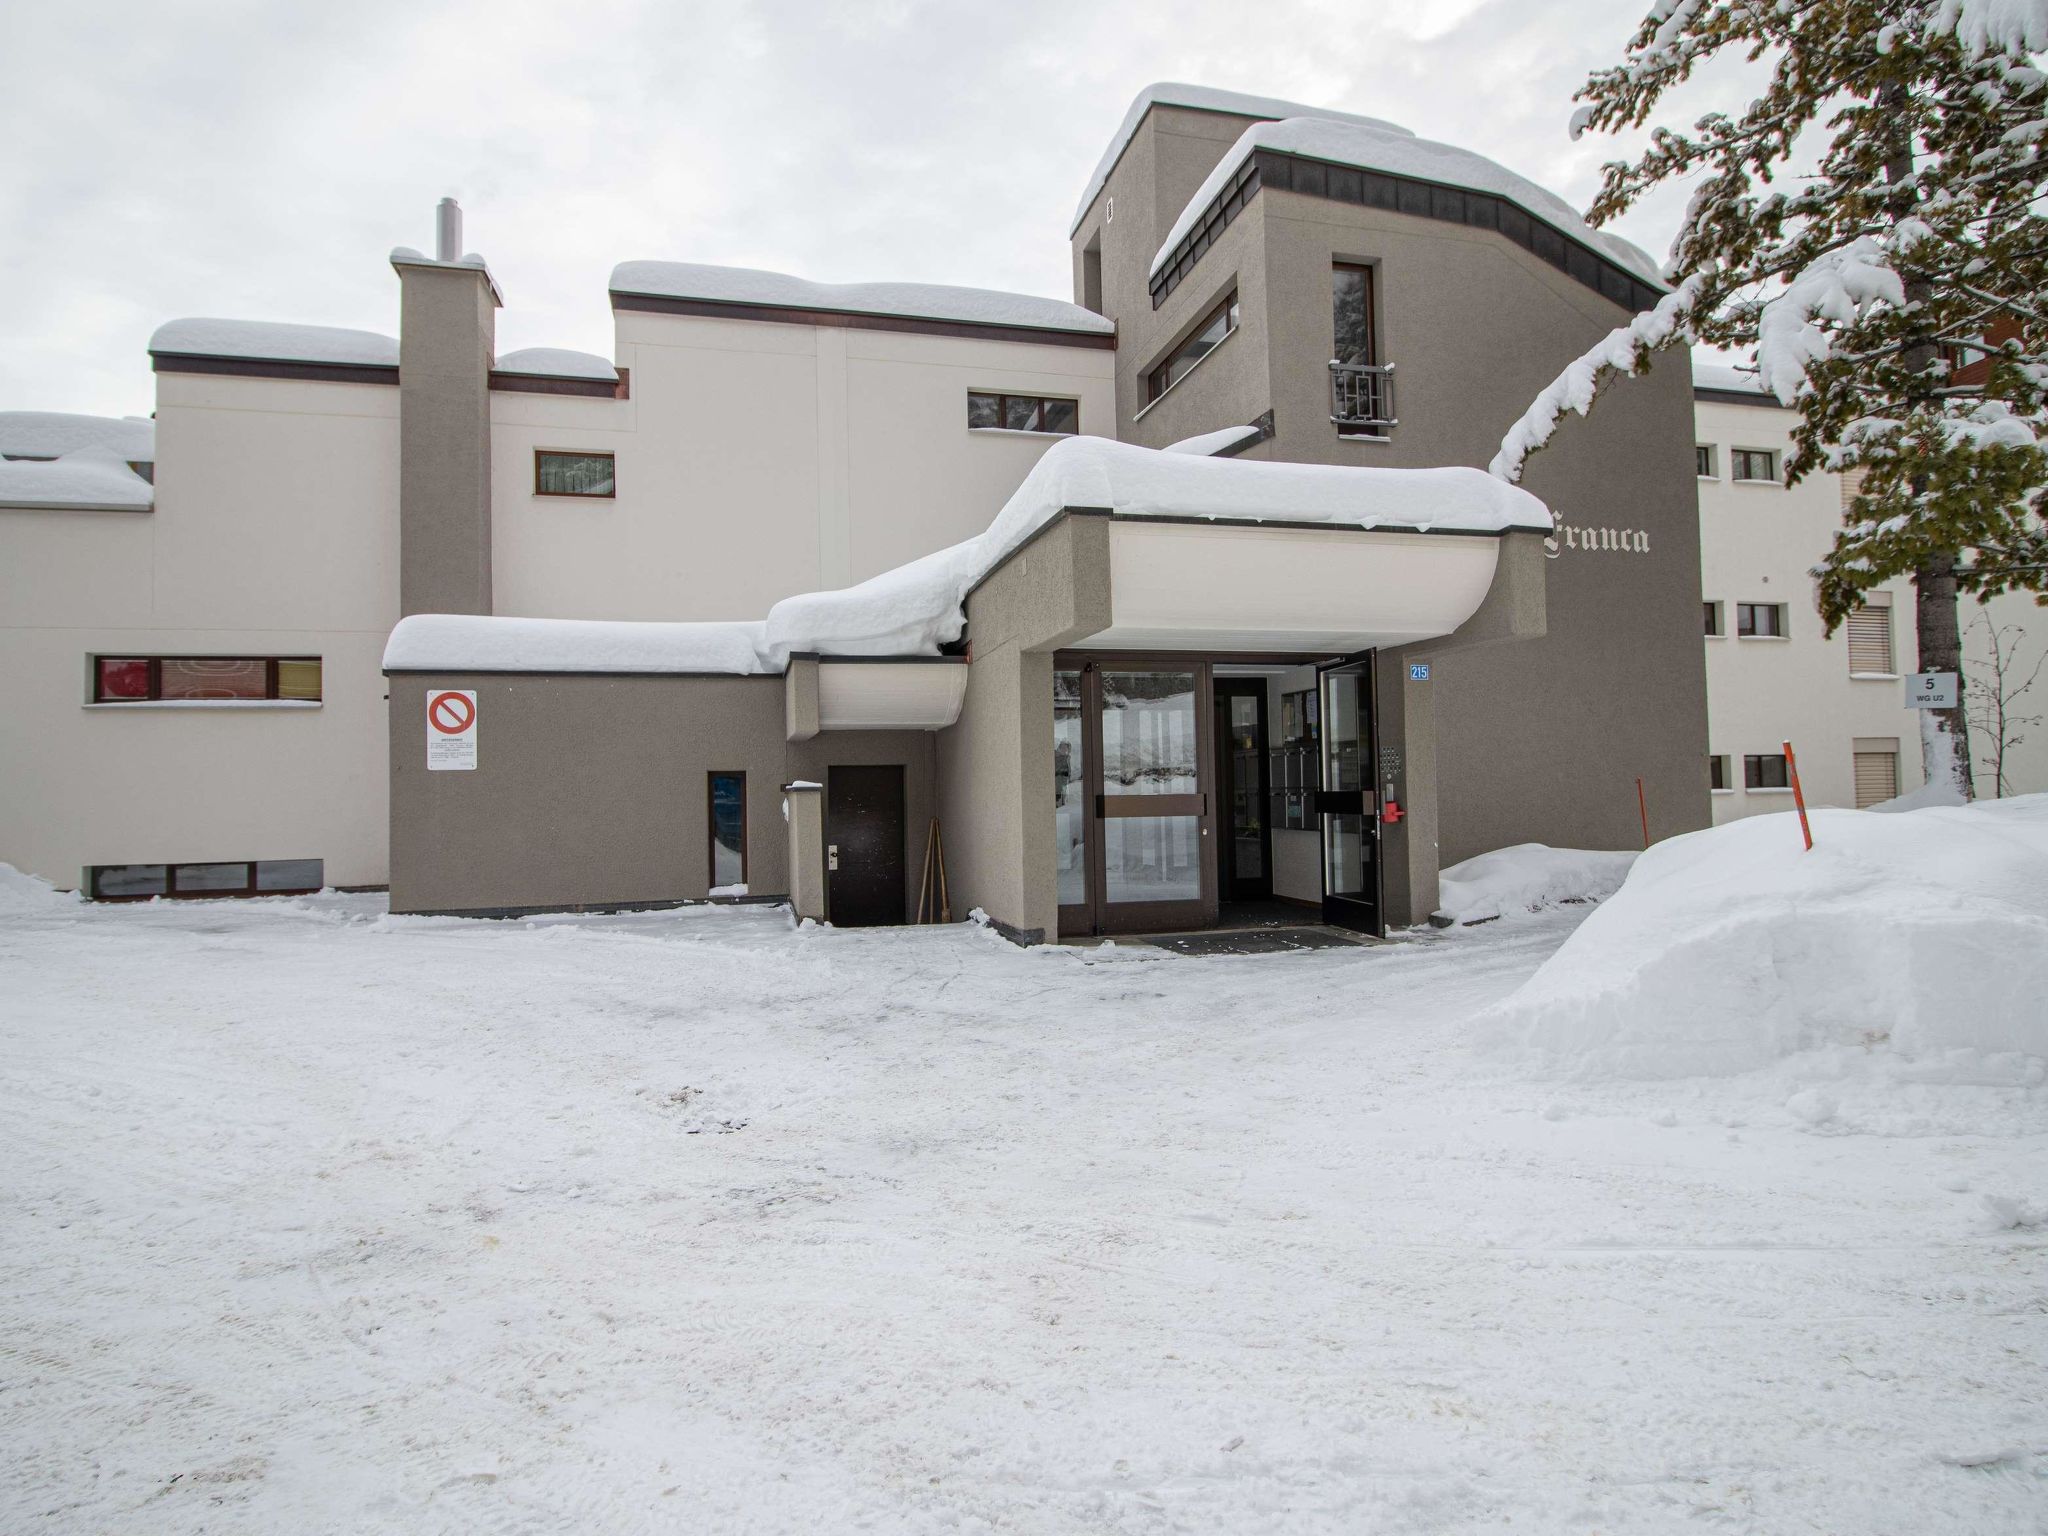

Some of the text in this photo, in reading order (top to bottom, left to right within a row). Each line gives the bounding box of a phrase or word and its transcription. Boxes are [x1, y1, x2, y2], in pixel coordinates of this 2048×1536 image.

[1543, 509, 1650, 559] Franca
[1412, 666, 1427, 678] 215
[1925, 678, 1935, 690] 5
[1916, 694, 1945, 702] WG U2
